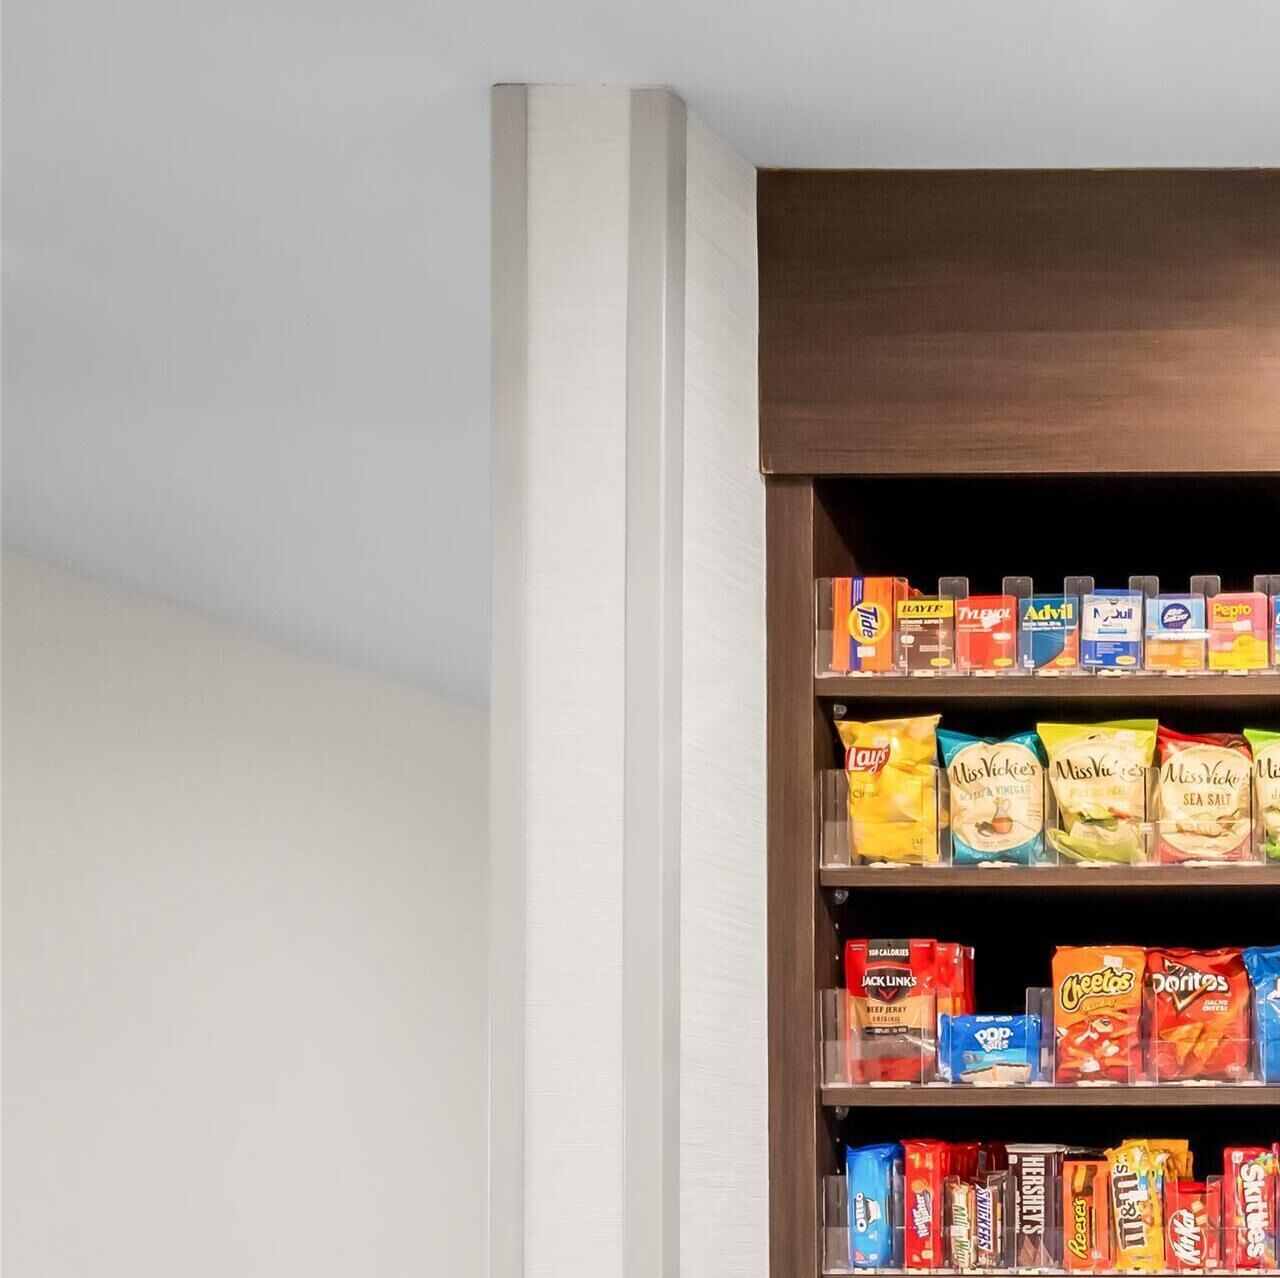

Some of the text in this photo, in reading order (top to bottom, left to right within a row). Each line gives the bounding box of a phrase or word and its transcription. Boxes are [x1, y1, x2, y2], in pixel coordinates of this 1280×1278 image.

[857, 606, 879, 639] Tide
[901, 604, 943, 613] BAYER
[1023, 603, 1073, 620] Advil
[1213, 603, 1251, 617] Pepto
[953, 751, 1037, 785] Miss Vickie's
[1056, 754, 1144, 782] Miss Vicie's
[1183, 793, 1231, 806] SEA SALT
[879, 948, 909, 957] CALORIES
[861, 976, 886, 987] JACK
[1061, 967, 1134, 1012] Cheetos
[1152, 973, 1229, 993] Doritos
[855, 1192, 867, 1233] OREO
[975, 1184, 993, 1251] SNICKERS
[1240, 1162, 1269, 1258] Skittles
[1067, 1197, 1088, 1260] Reese's
